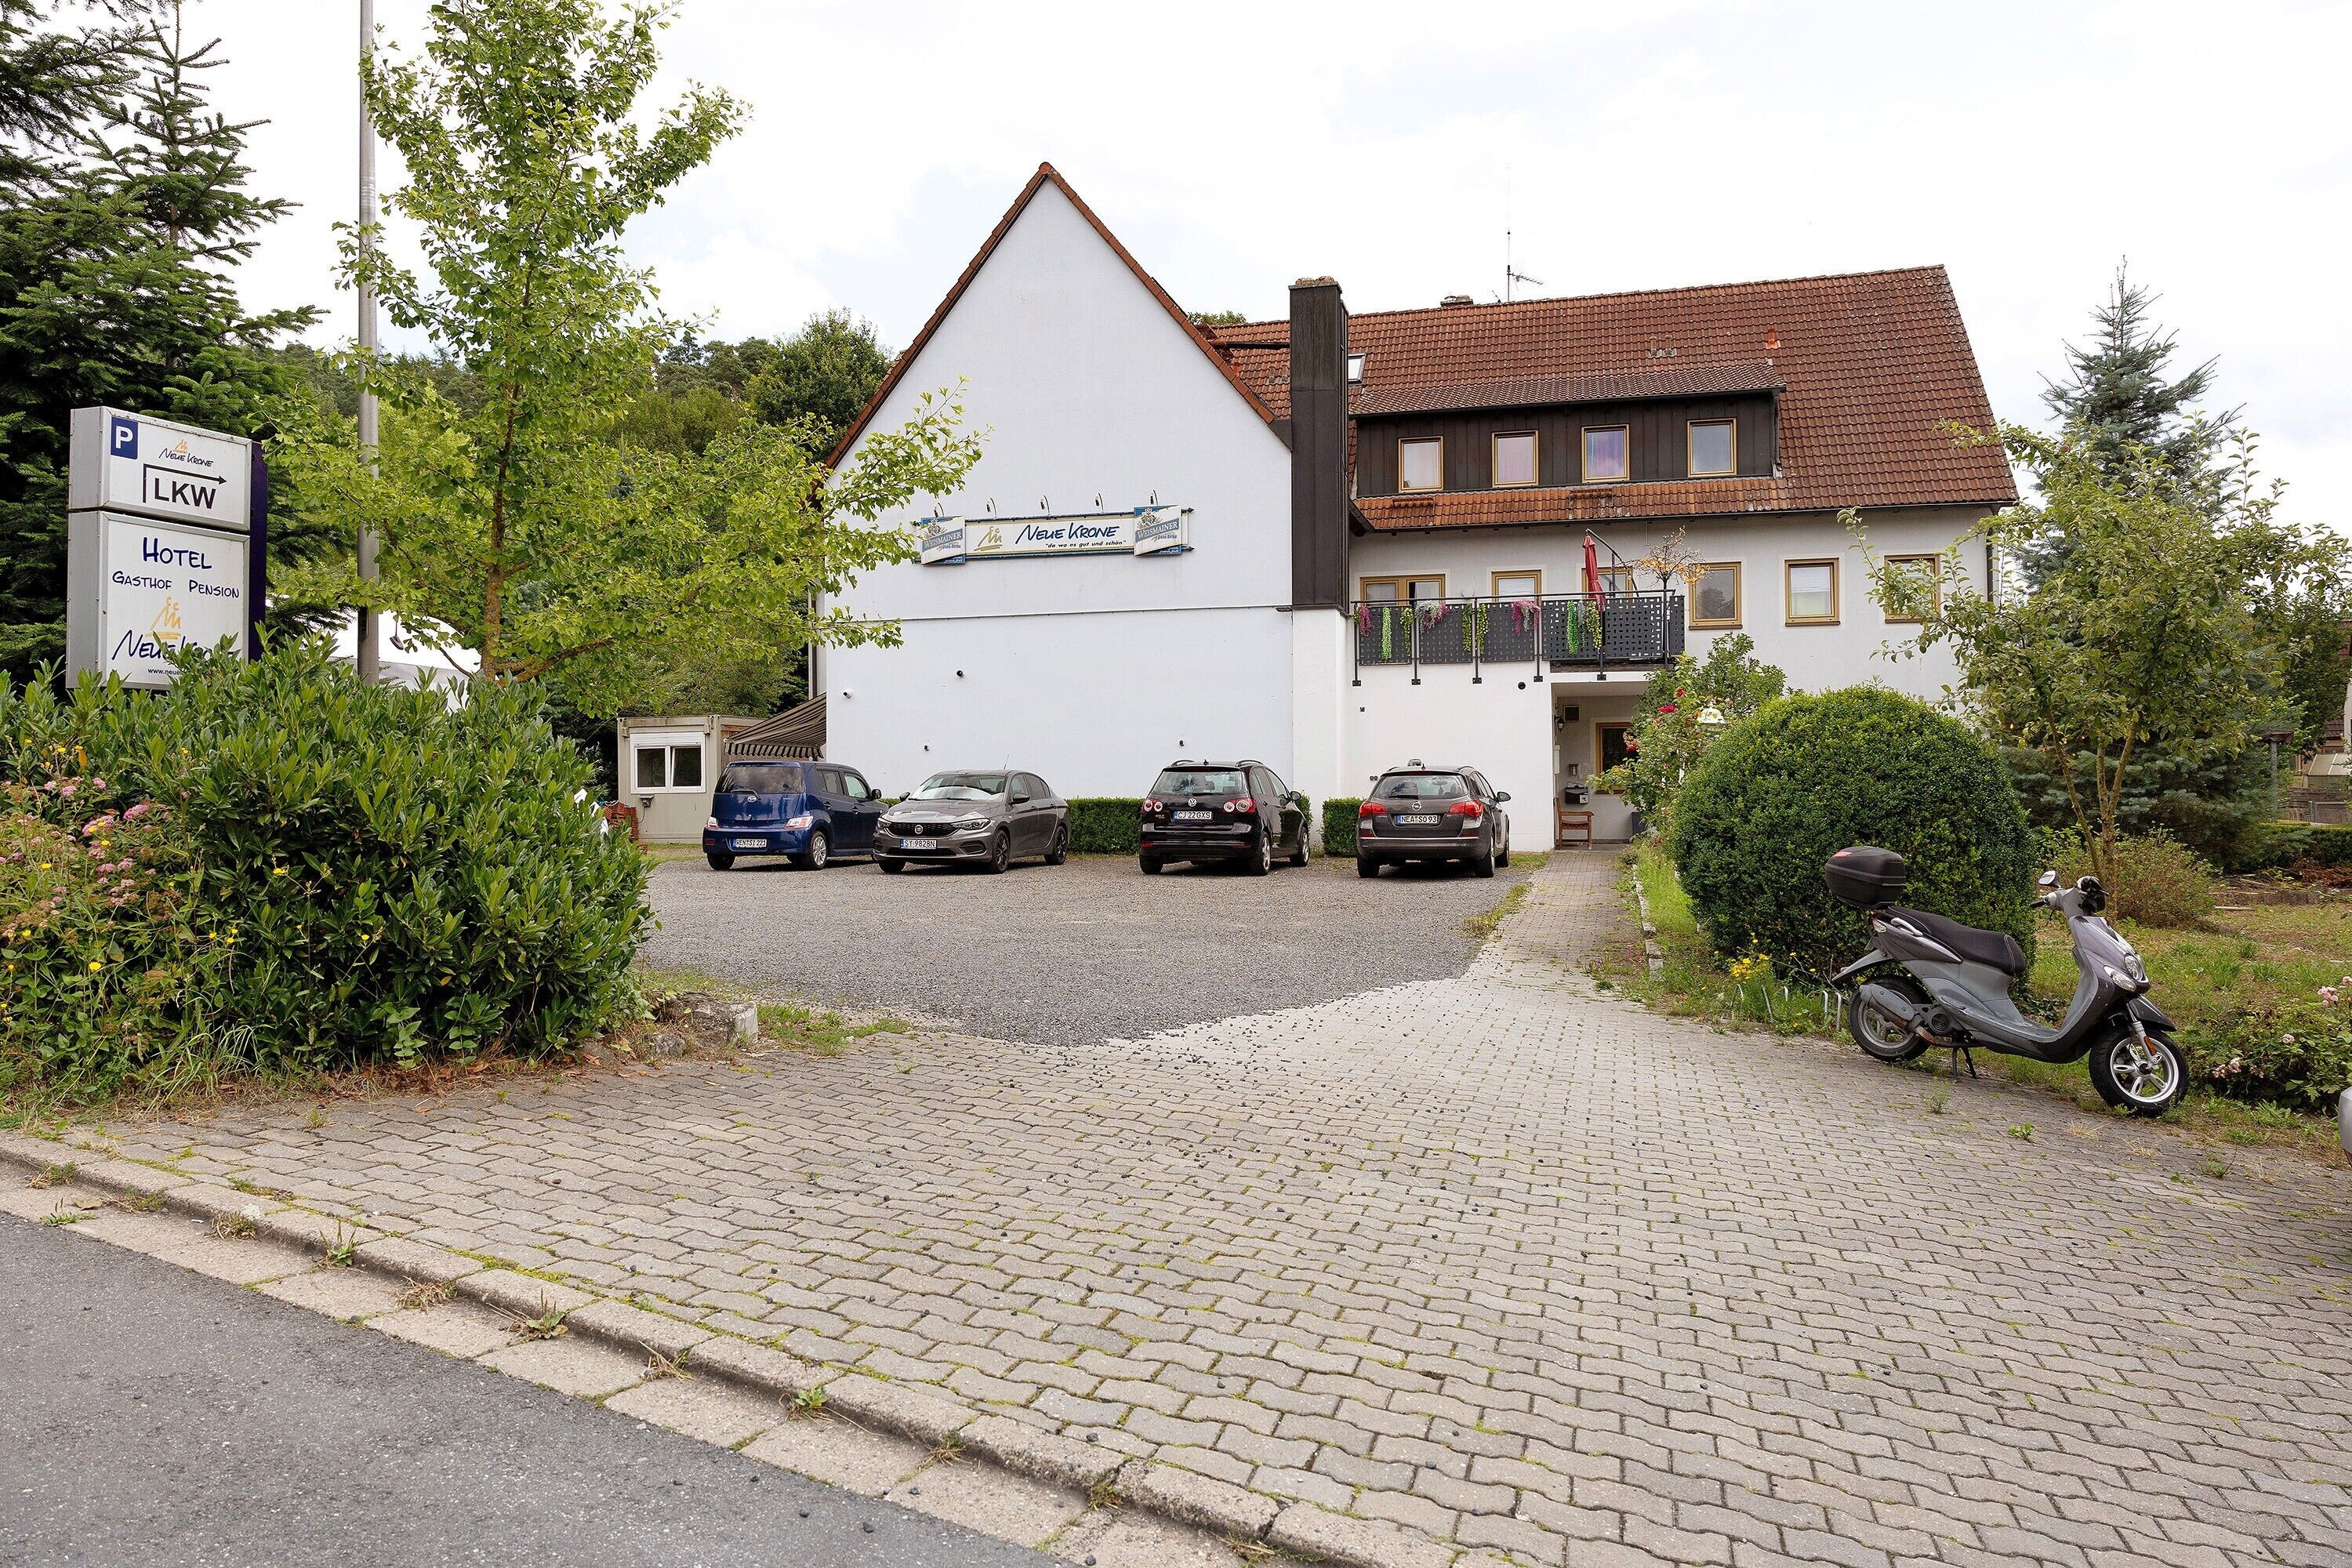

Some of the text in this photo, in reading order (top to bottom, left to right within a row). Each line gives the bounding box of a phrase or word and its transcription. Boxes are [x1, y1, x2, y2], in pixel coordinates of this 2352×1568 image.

[115, 426, 133, 449] P
[187, 452, 214, 467] KRONE
[154, 477, 216, 510] LKW
[1014, 522, 1120, 545] NEUE KRONE
[188, 579, 240, 598] PENSION
